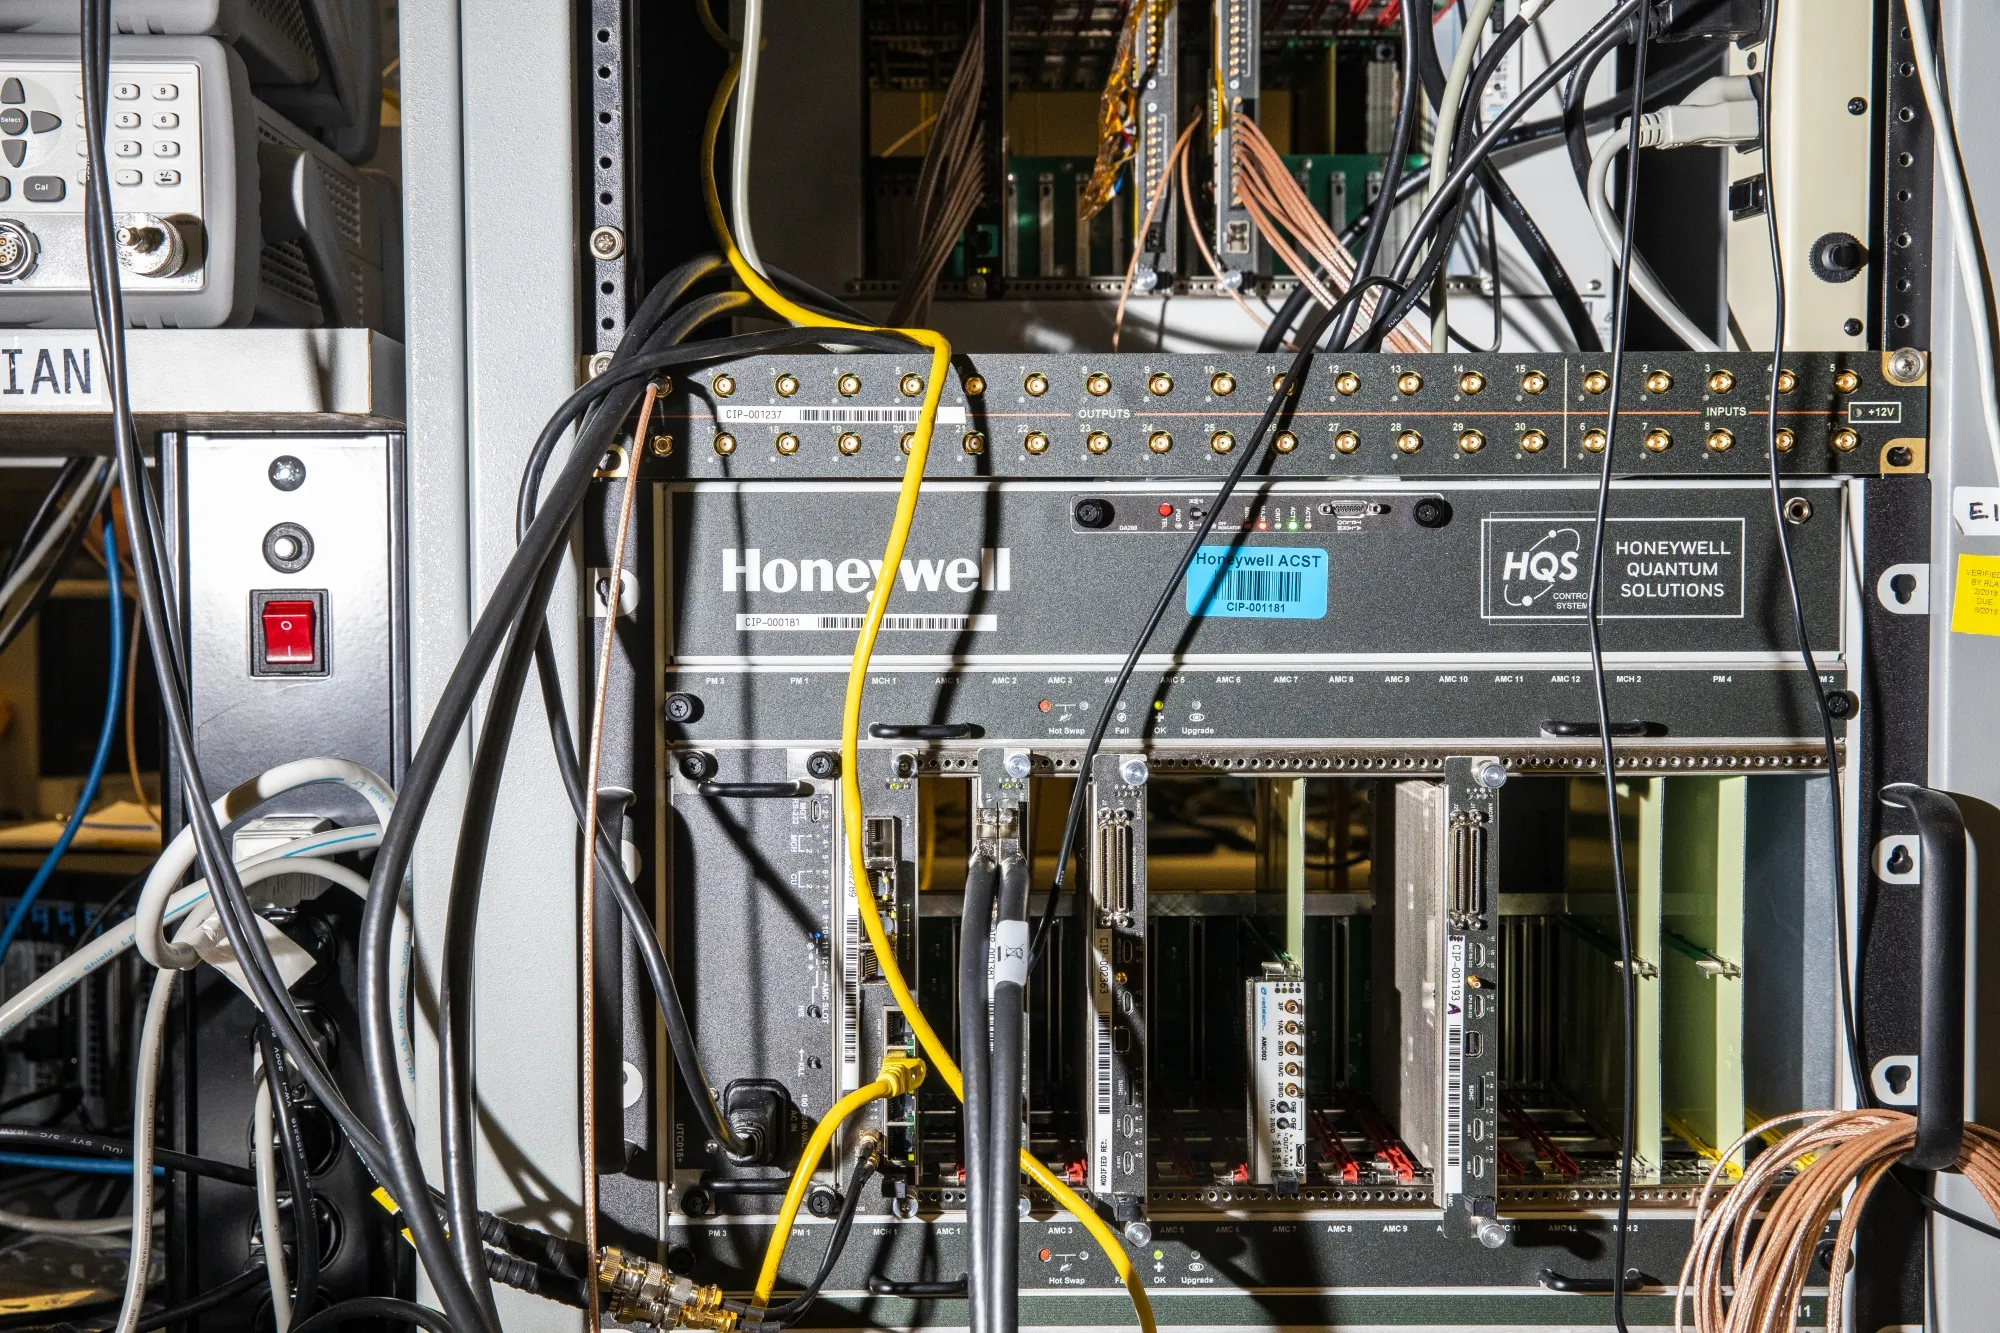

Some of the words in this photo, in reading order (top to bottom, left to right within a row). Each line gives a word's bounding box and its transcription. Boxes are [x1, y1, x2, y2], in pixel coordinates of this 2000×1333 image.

[121, 87, 127, 95] 8
[160, 87, 166, 95] 9
[123, 144, 129, 152] 2
[162, 144, 168, 152] 3
[34, 183, 49, 191] Cal
[769, 367, 776, 375] 3
[832, 367, 839, 375] 4
[894, 367, 901, 375] 5
[726, 410, 782, 420] CIP-001237
[1078, 409, 1131, 420] OUTPUTS
[1707, 407, 1747, 417] INPUTS
[1868, 407, 1895, 416] +12V
[706, 426, 717, 435] 17
[768, 426, 779, 435] 18
[831, 426, 842, 435] 19
[893, 426, 905, 435] 20
[955, 426, 967, 434] 21
[1017, 425, 1029, 434] 22
[1079, 424, 1092, 433] 23
[1142, 424, 1153, 433] 24
[1203, 424, 1216, 433] 25
[1328, 423, 1340, 432] 27
[1390, 422, 1402, 432] 28
[1452, 422, 1464, 432] 29
[1515, 422, 1526, 432] 30
[1579, 422, 1586, 431] 6
[1642, 422, 1648, 431] 7
[1704, 422, 1711, 431] 8
[1615, 541, 1731, 555] HONEYWELL
[1196, 552, 1275, 568] Honeywell
[1278, 554, 1322, 568] ACST
[1503, 551, 1579, 583] HQS
[1626, 562, 1718, 577] QUANTUM
[1971, 578, 1982, 586] BY
[1620, 583, 1725, 598] SOLUTIONS
[1553, 592, 1589, 600] CONTRO
[1976, 597, 1994, 605] DUE
[1226, 601, 1286, 614] CIP-001181
[745, 617, 800, 628] CIP-000181
[871, 677, 888, 685] MCH
[892, 677, 896, 685] 1
[991, 676, 1009, 684] AMC
[1010, 676, 1017, 684] 2
[1048, 676, 1065, 684] AMC
[1066, 676, 1072, 684] 3
[1180, 676, 1186, 684] 5
[1216, 676, 1233, 684] AMC
[1234, 676, 1241, 684] 6
[1273, 676, 1290, 684] AMC
[1292, 676, 1298, 684] 7
[1328, 676, 1346, 684] AMC
[1348, 676, 1354, 684] 8
[1384, 676, 1402, 684] AMC
[1404, 676, 1410, 684] 9
[1048, 727, 1062, 735] Hot
[1063, 727, 1085, 737] Swap
[1115, 727, 1129, 735] Fail
[1181, 727, 1215, 737] Upgrade
[83, 948, 114, 973] Shield
[1099, 937, 1109, 994] CIP-002363
[1452, 945, 1461, 1001] CIP-001193
[791, 1110, 797, 1121] AC
[791, 1124, 797, 1132] IN
[40, 1132, 60, 1140] 3/C
[70, 1137, 92, 1147] SVT
[676, 1123, 684, 1163] UTC018+
[102, 1143, 123, 1154] (UL)
[873, 1228, 890, 1236] MCH
[936, 1228, 953, 1236] AMC
[956, 1228, 960, 1236] 1
[1160, 1226, 1177, 1234] AMC
[1215, 1226, 1232, 1234] AMC
[1548, 1224, 1566, 1232] AMC
[1612, 1224, 1631, 1232] MH
[1632, 1224, 1638, 1232] 2
[1048, 1276, 1063, 1284] Hot
[1064, 1276, 1085, 1286] Swap
[1154, 1276, 1166, 1284] OK
[1181, 1276, 1214, 1286] Upgrade
